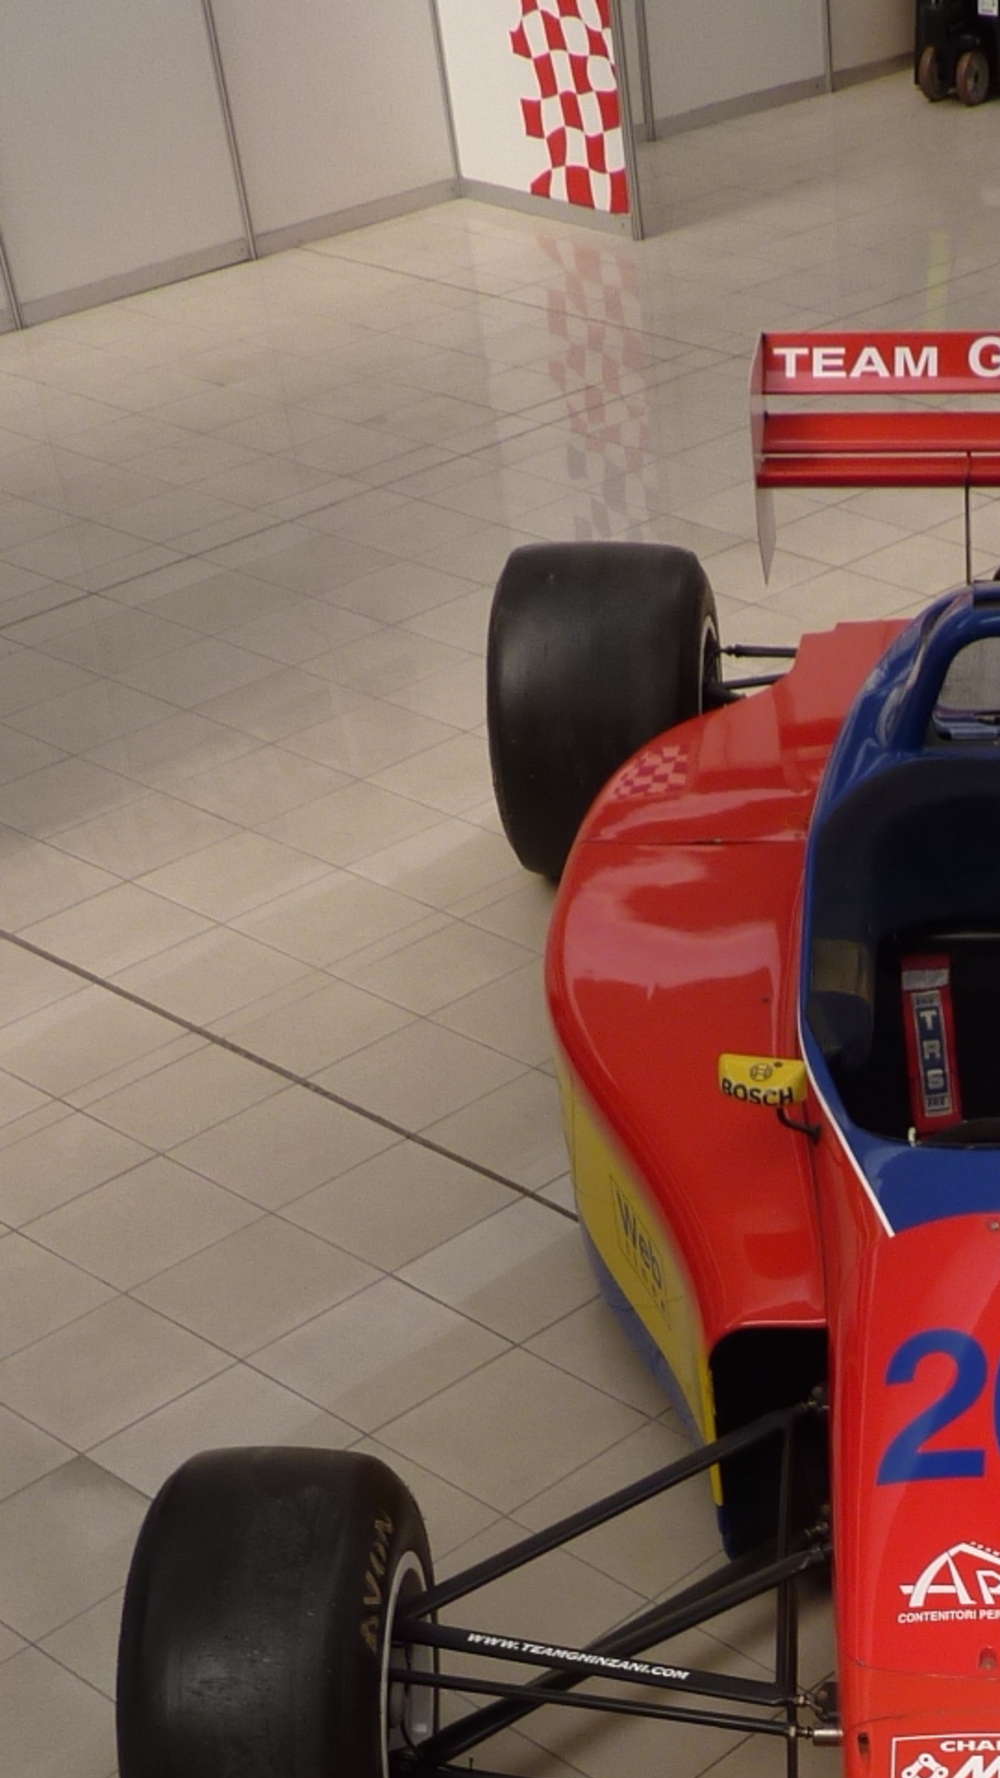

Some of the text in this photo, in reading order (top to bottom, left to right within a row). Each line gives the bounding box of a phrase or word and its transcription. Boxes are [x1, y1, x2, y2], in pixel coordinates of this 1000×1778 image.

[772, 346, 938, 379] TEAM
[721, 1077, 794, 1106] BOSCH
[897, 1609, 977, 1625] CONTENITORI
[467, 1632, 692, 1681] WWW.TEAMGHINZANI.COM
